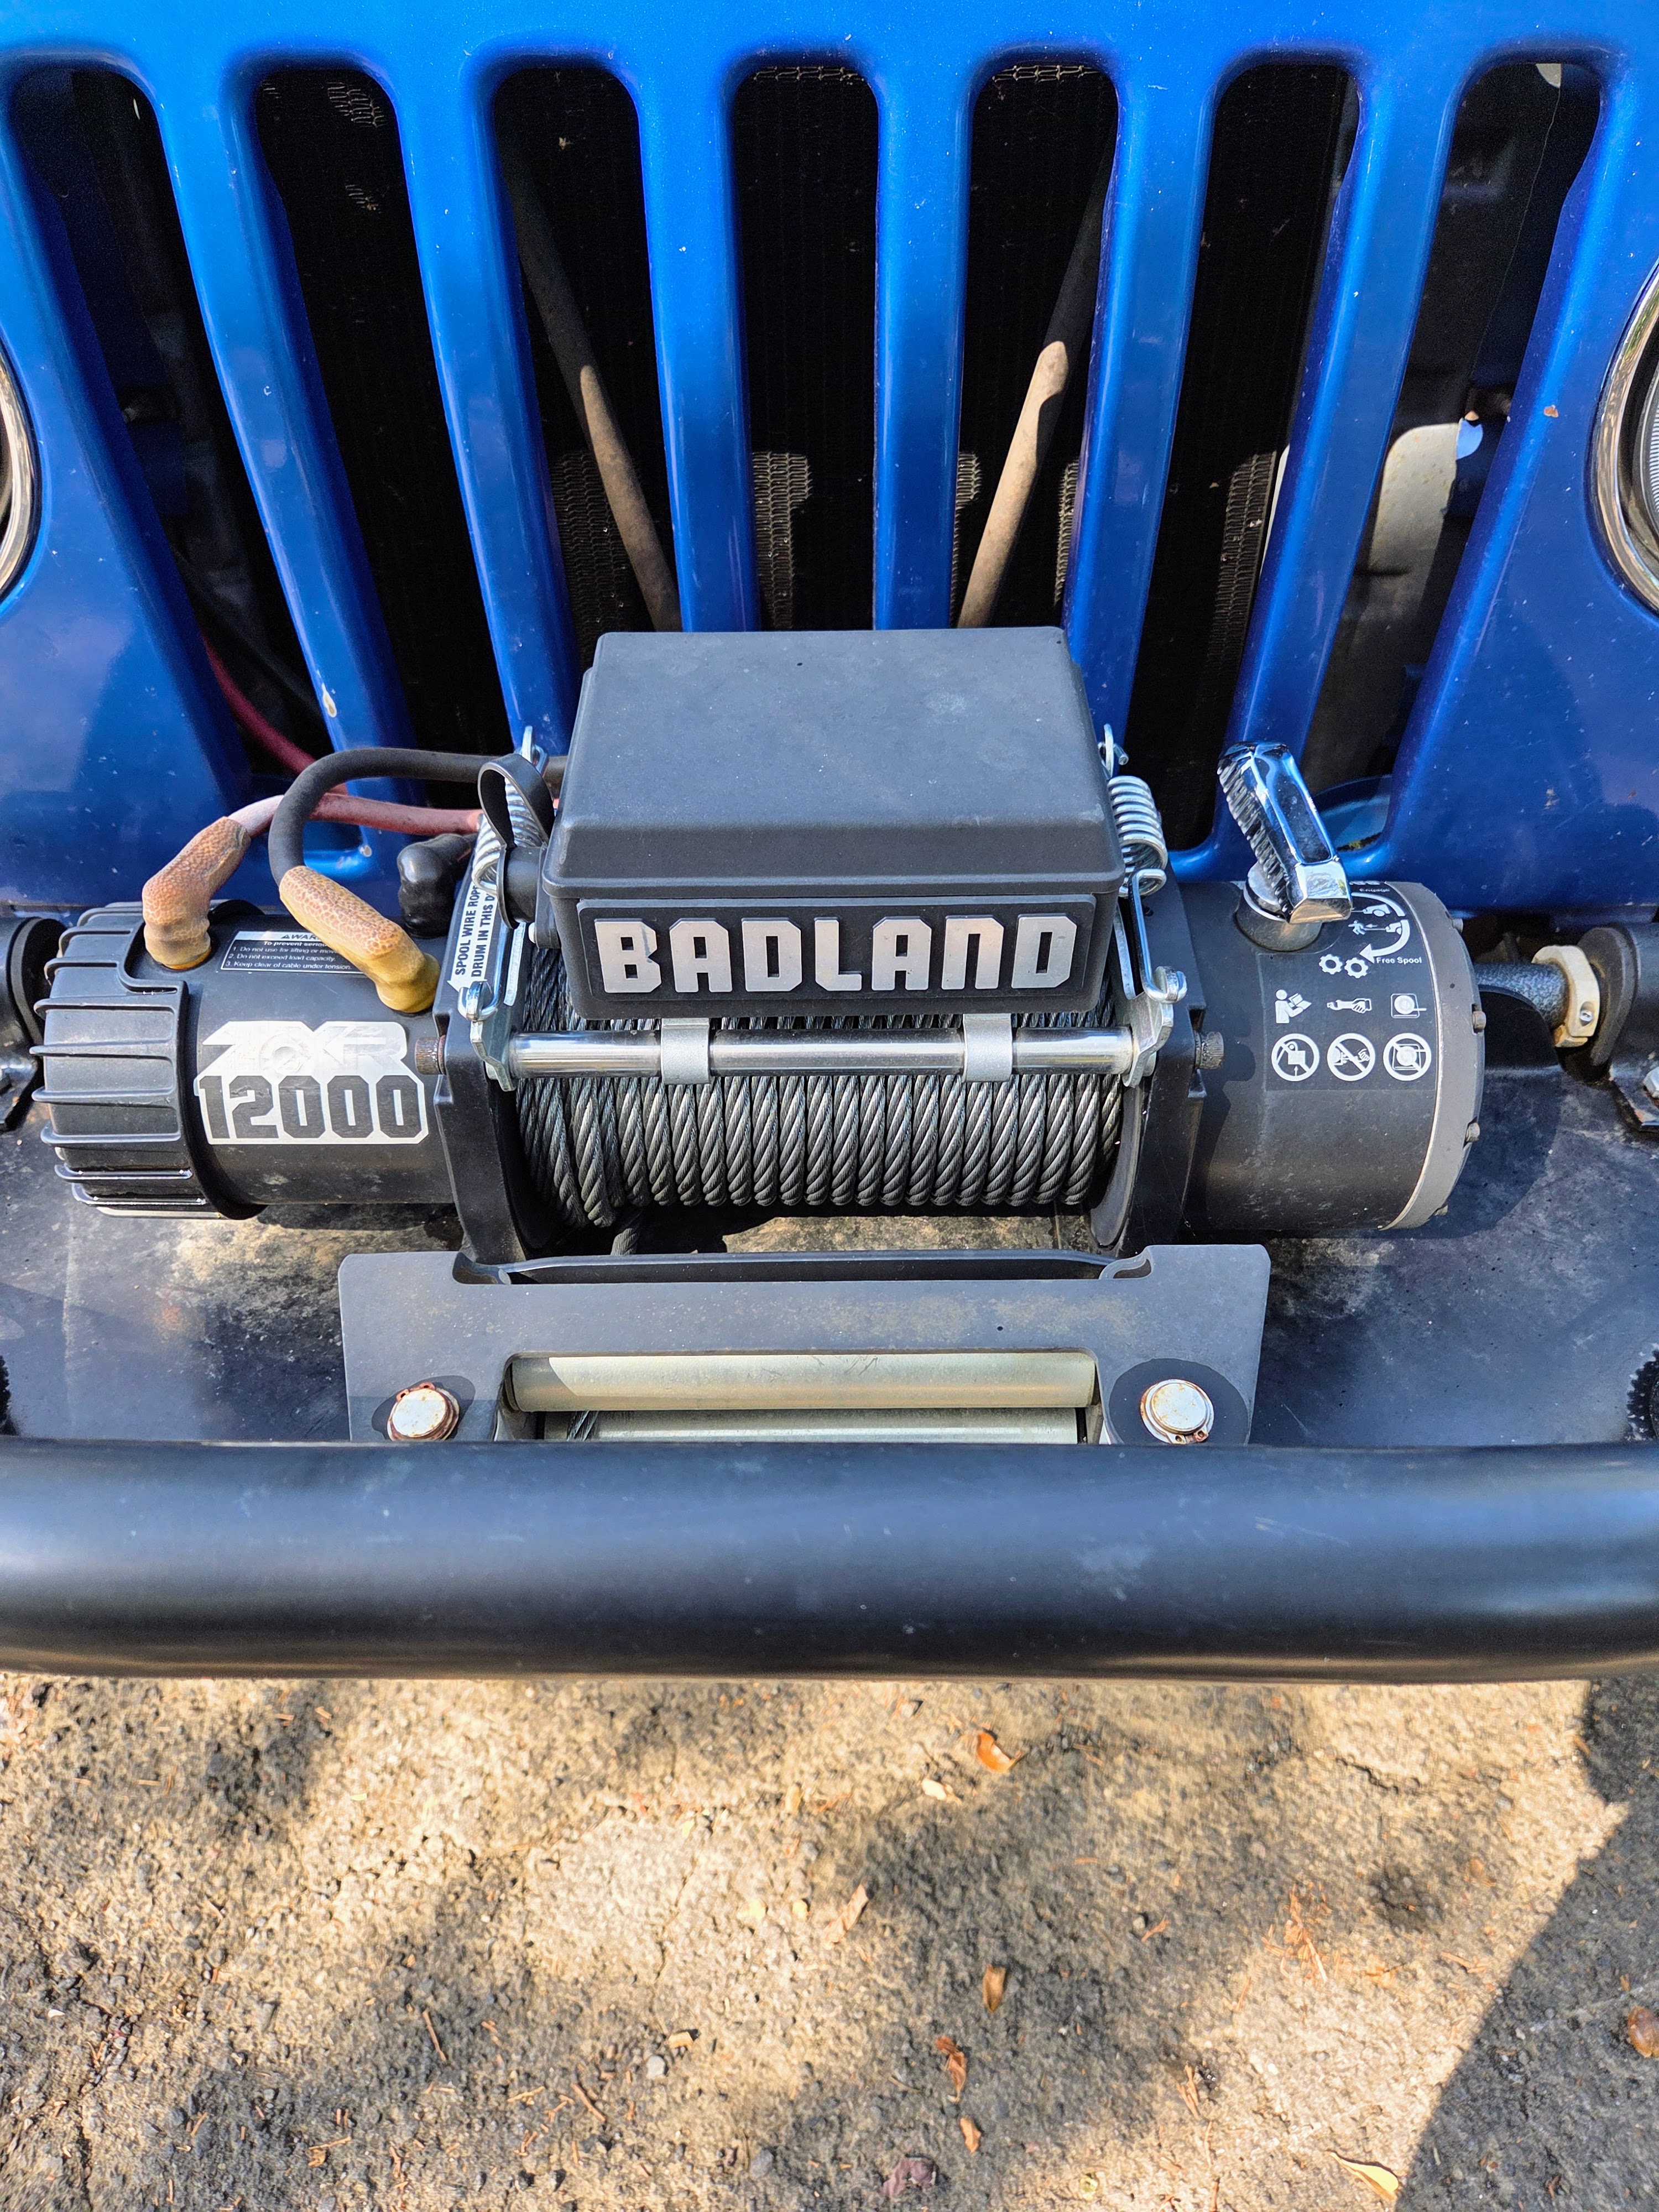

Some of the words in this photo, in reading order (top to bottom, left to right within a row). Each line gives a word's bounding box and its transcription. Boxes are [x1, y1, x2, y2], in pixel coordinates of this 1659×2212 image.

[462, 910, 477, 937] WIRE
[479, 904, 494, 927] THIS
[477, 930, 489, 941] IN
[455, 940, 471, 975] SPOOL
[471, 945, 487, 977] DRUM
[594, 913, 1077, 993] BADLAND
[1397, 957, 1422, 965] Spool
[199, 1075, 422, 1139] 12000
